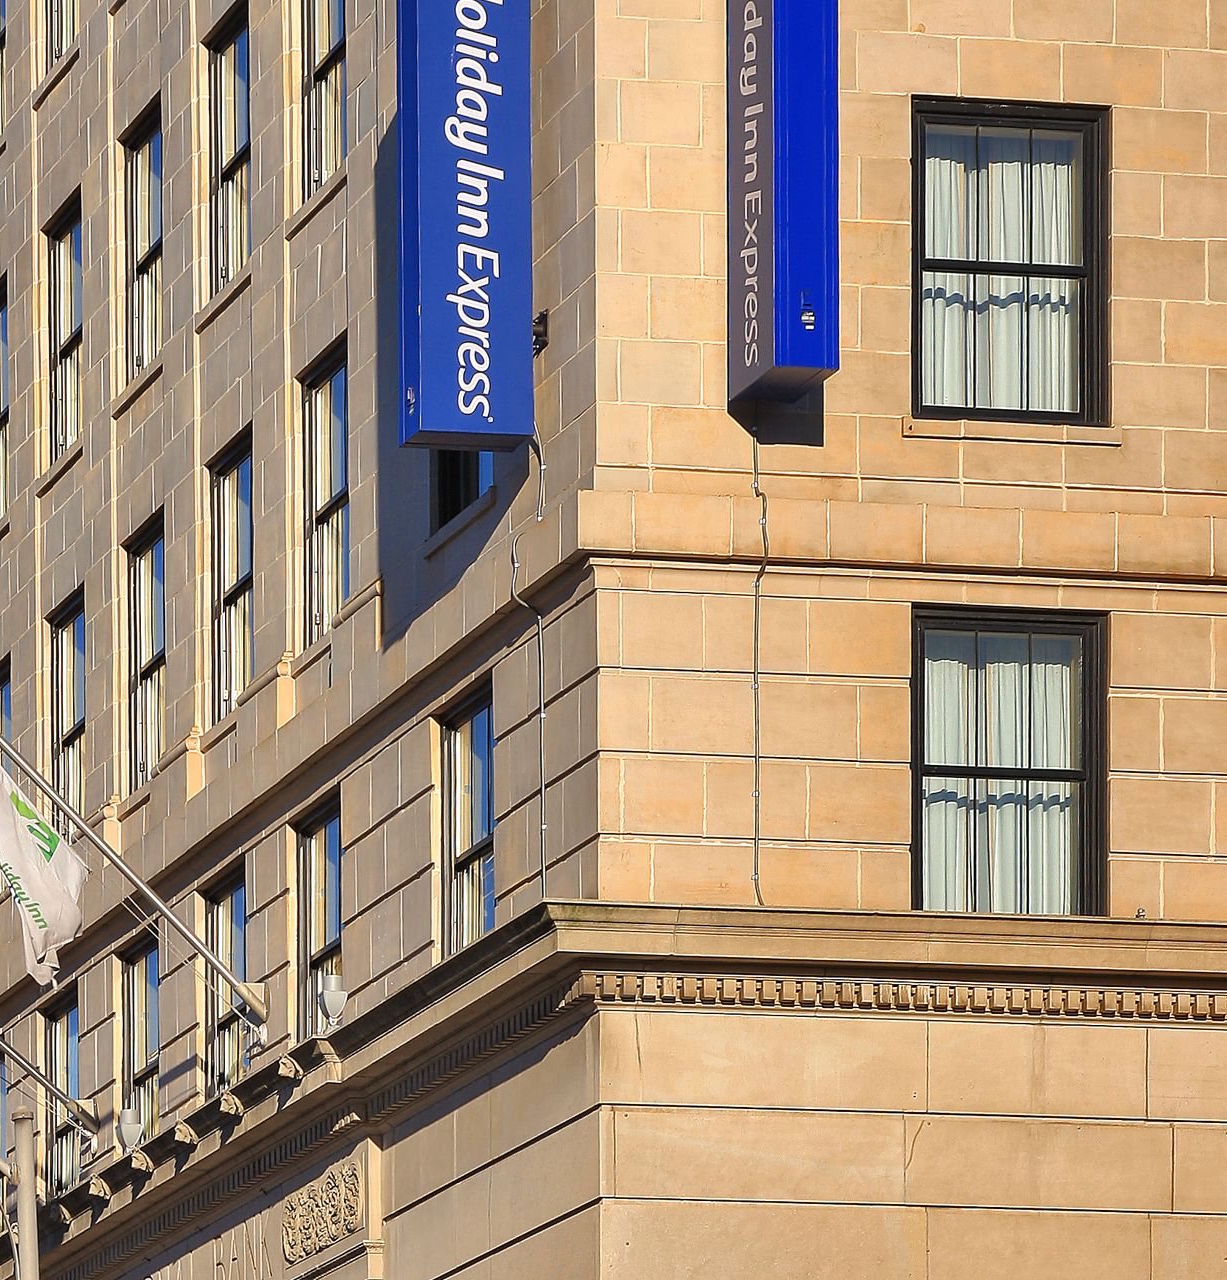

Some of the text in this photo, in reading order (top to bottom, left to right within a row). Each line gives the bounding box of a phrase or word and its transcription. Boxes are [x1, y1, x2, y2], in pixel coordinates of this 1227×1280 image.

[744, 103, 764, 184] Inn
[456, 159, 505, 238] Inn
[740, 189, 762, 368] Express
[446, 242, 501, 419] Express
[25, 902, 49, 930] Inn
